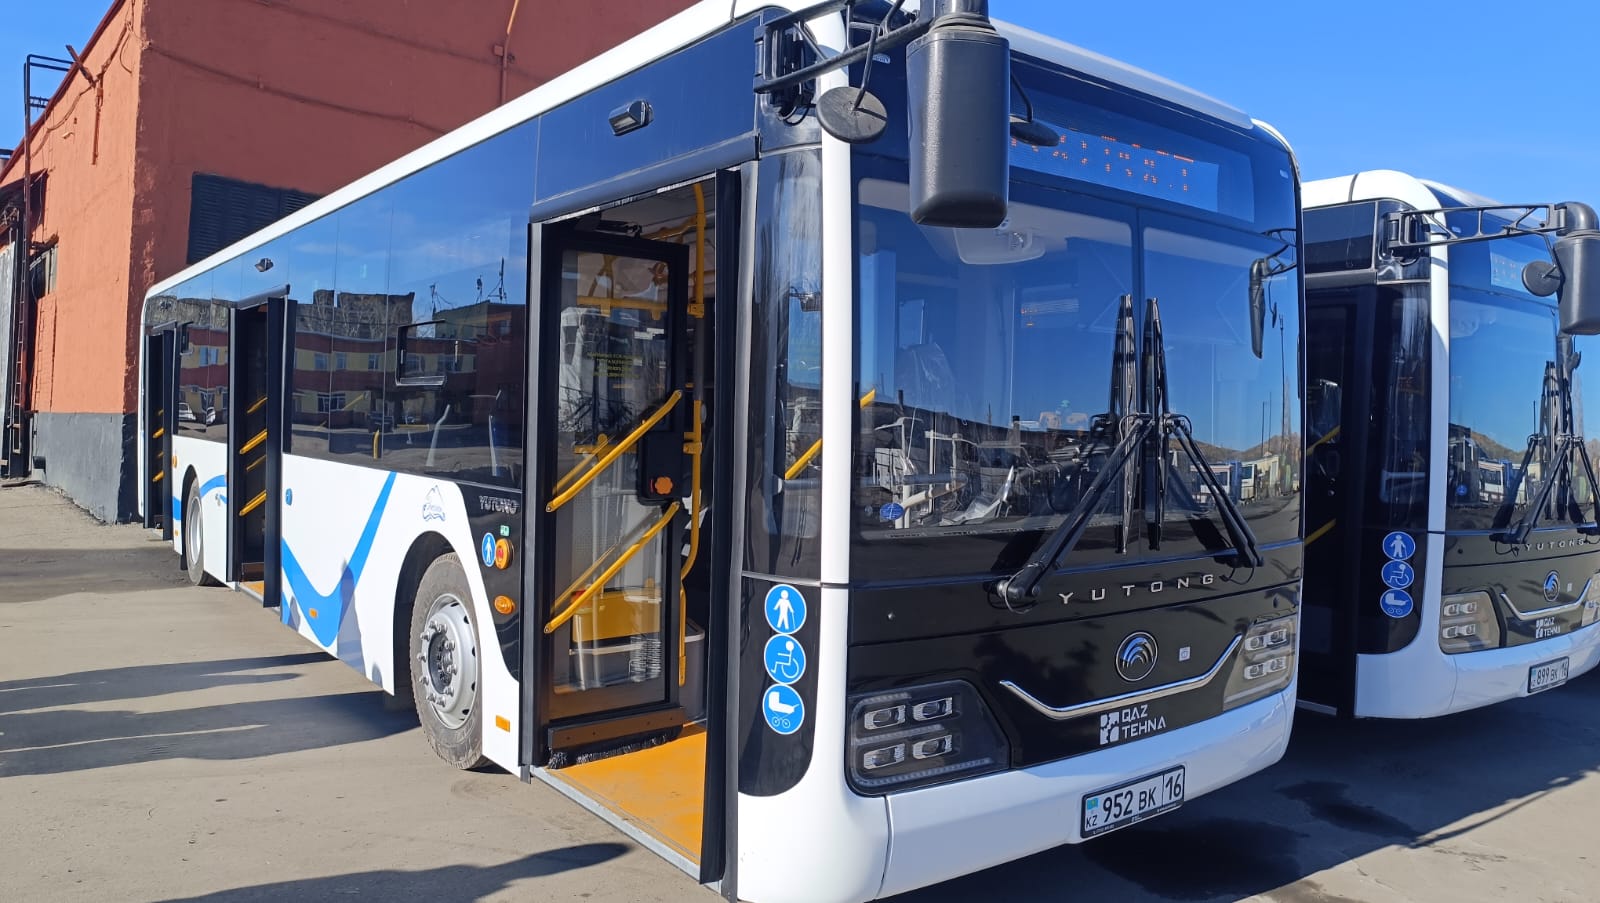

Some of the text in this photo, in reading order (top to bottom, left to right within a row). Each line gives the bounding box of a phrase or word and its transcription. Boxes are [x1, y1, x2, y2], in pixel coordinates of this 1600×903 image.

[1526, 538, 1584, 551] YUTONG
[1059, 574, 1214, 604] YUTONG
[1536, 667, 1550, 685] 899
[1122, 704, 1148, 722] QAZ
[1122, 716, 1166, 739] TEHNA
[1085, 773, 1182, 829] KZ 952 BK 16
